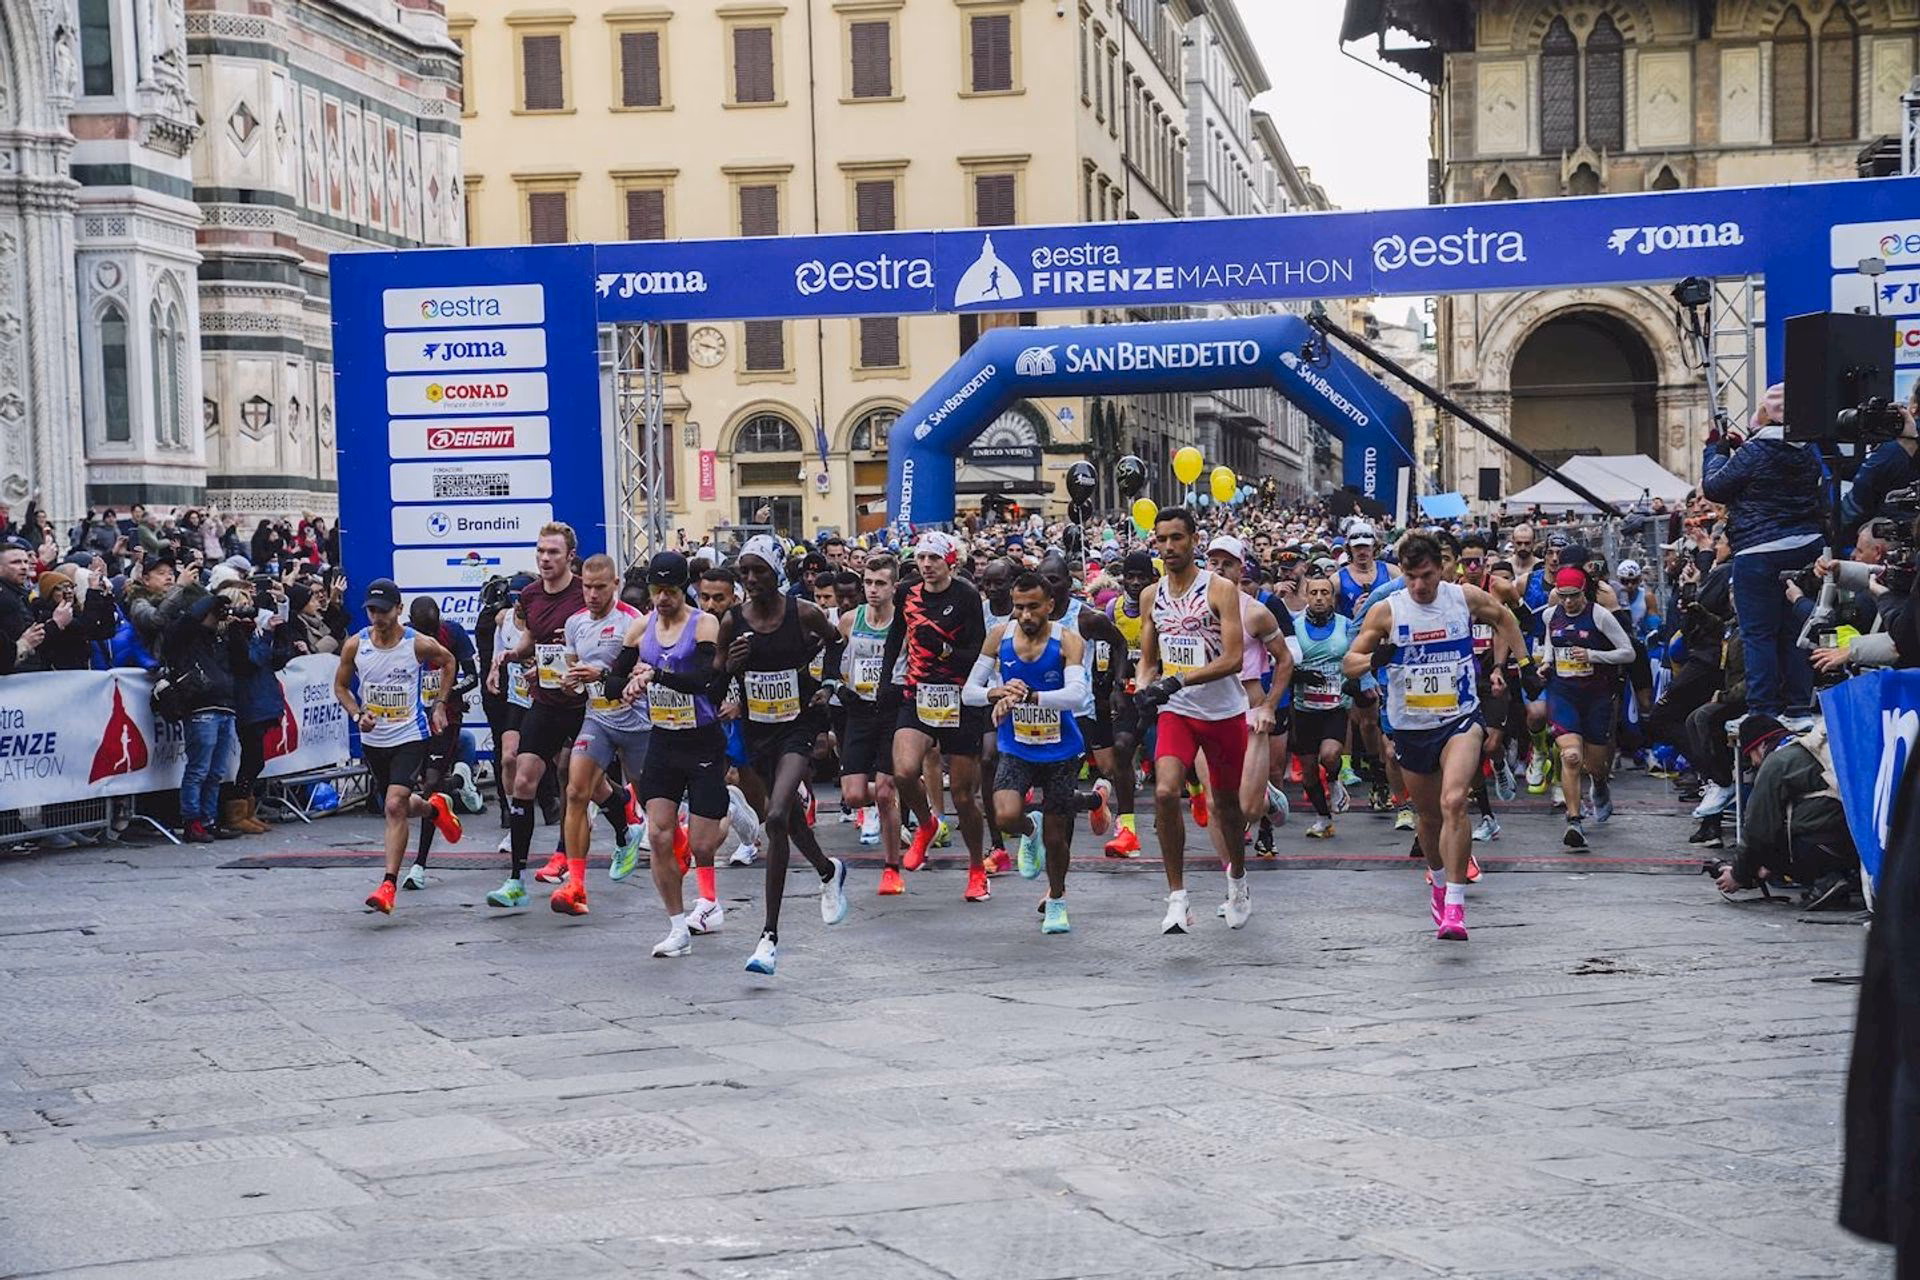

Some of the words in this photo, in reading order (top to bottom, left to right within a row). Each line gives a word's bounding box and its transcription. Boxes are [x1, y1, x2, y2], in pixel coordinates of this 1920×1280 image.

[1054, 242, 1120, 267] estra
[1409, 226, 1526, 267] estra
[829, 253, 935, 291] estra
[440, 296, 501, 317] estra
[445, 384, 509, 399] CONAD
[453, 431, 513, 447] ENERVIT
[457, 517, 519, 531] Brandini
[751, 682, 792, 700] EKIDOR
[1424, 675, 1439, 694] 20
[927, 693, 950, 708] 3510
[0, 706, 24, 730] tra
[1013, 706, 1059, 724] BOUFARS
[154, 720, 184, 743] FIR
[0, 755, 65, 782] ATHON
